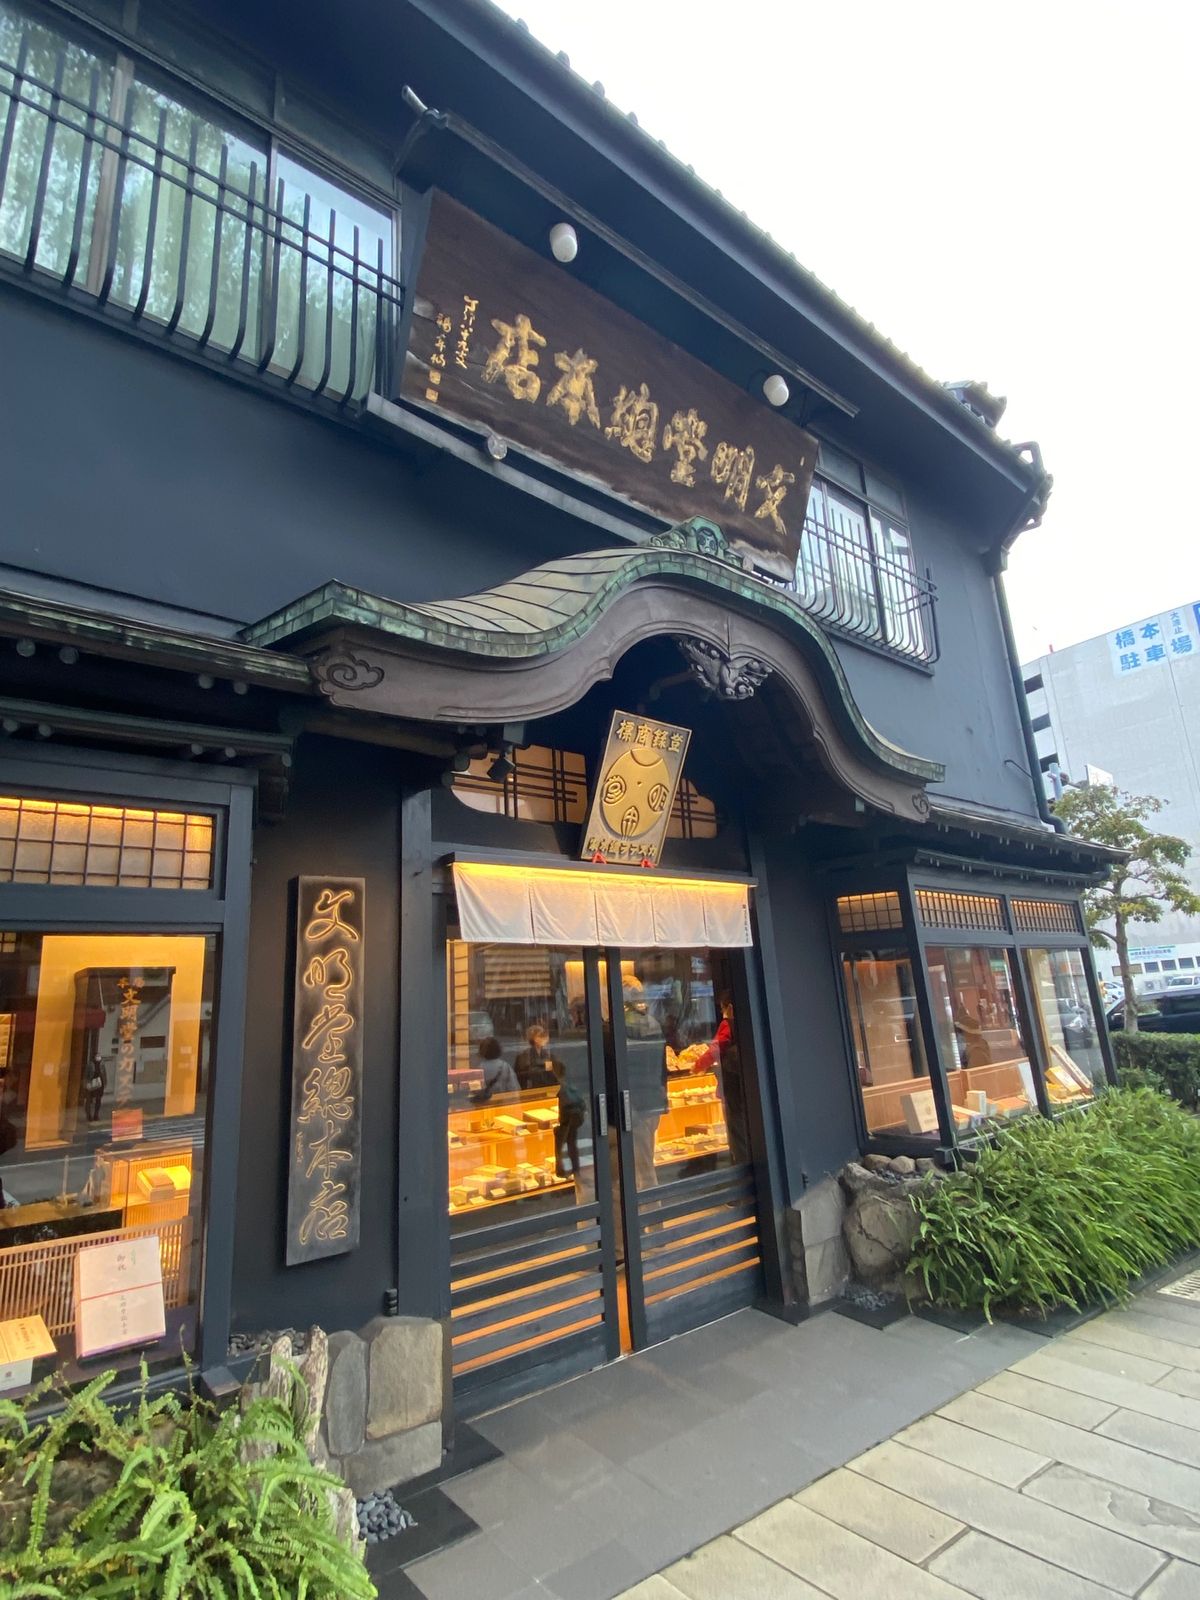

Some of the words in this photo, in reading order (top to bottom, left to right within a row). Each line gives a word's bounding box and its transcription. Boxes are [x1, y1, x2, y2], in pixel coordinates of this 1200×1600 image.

[1115, 621, 1160, 650] 橋本
[1119, 634, 1193, 672] 駐車場
